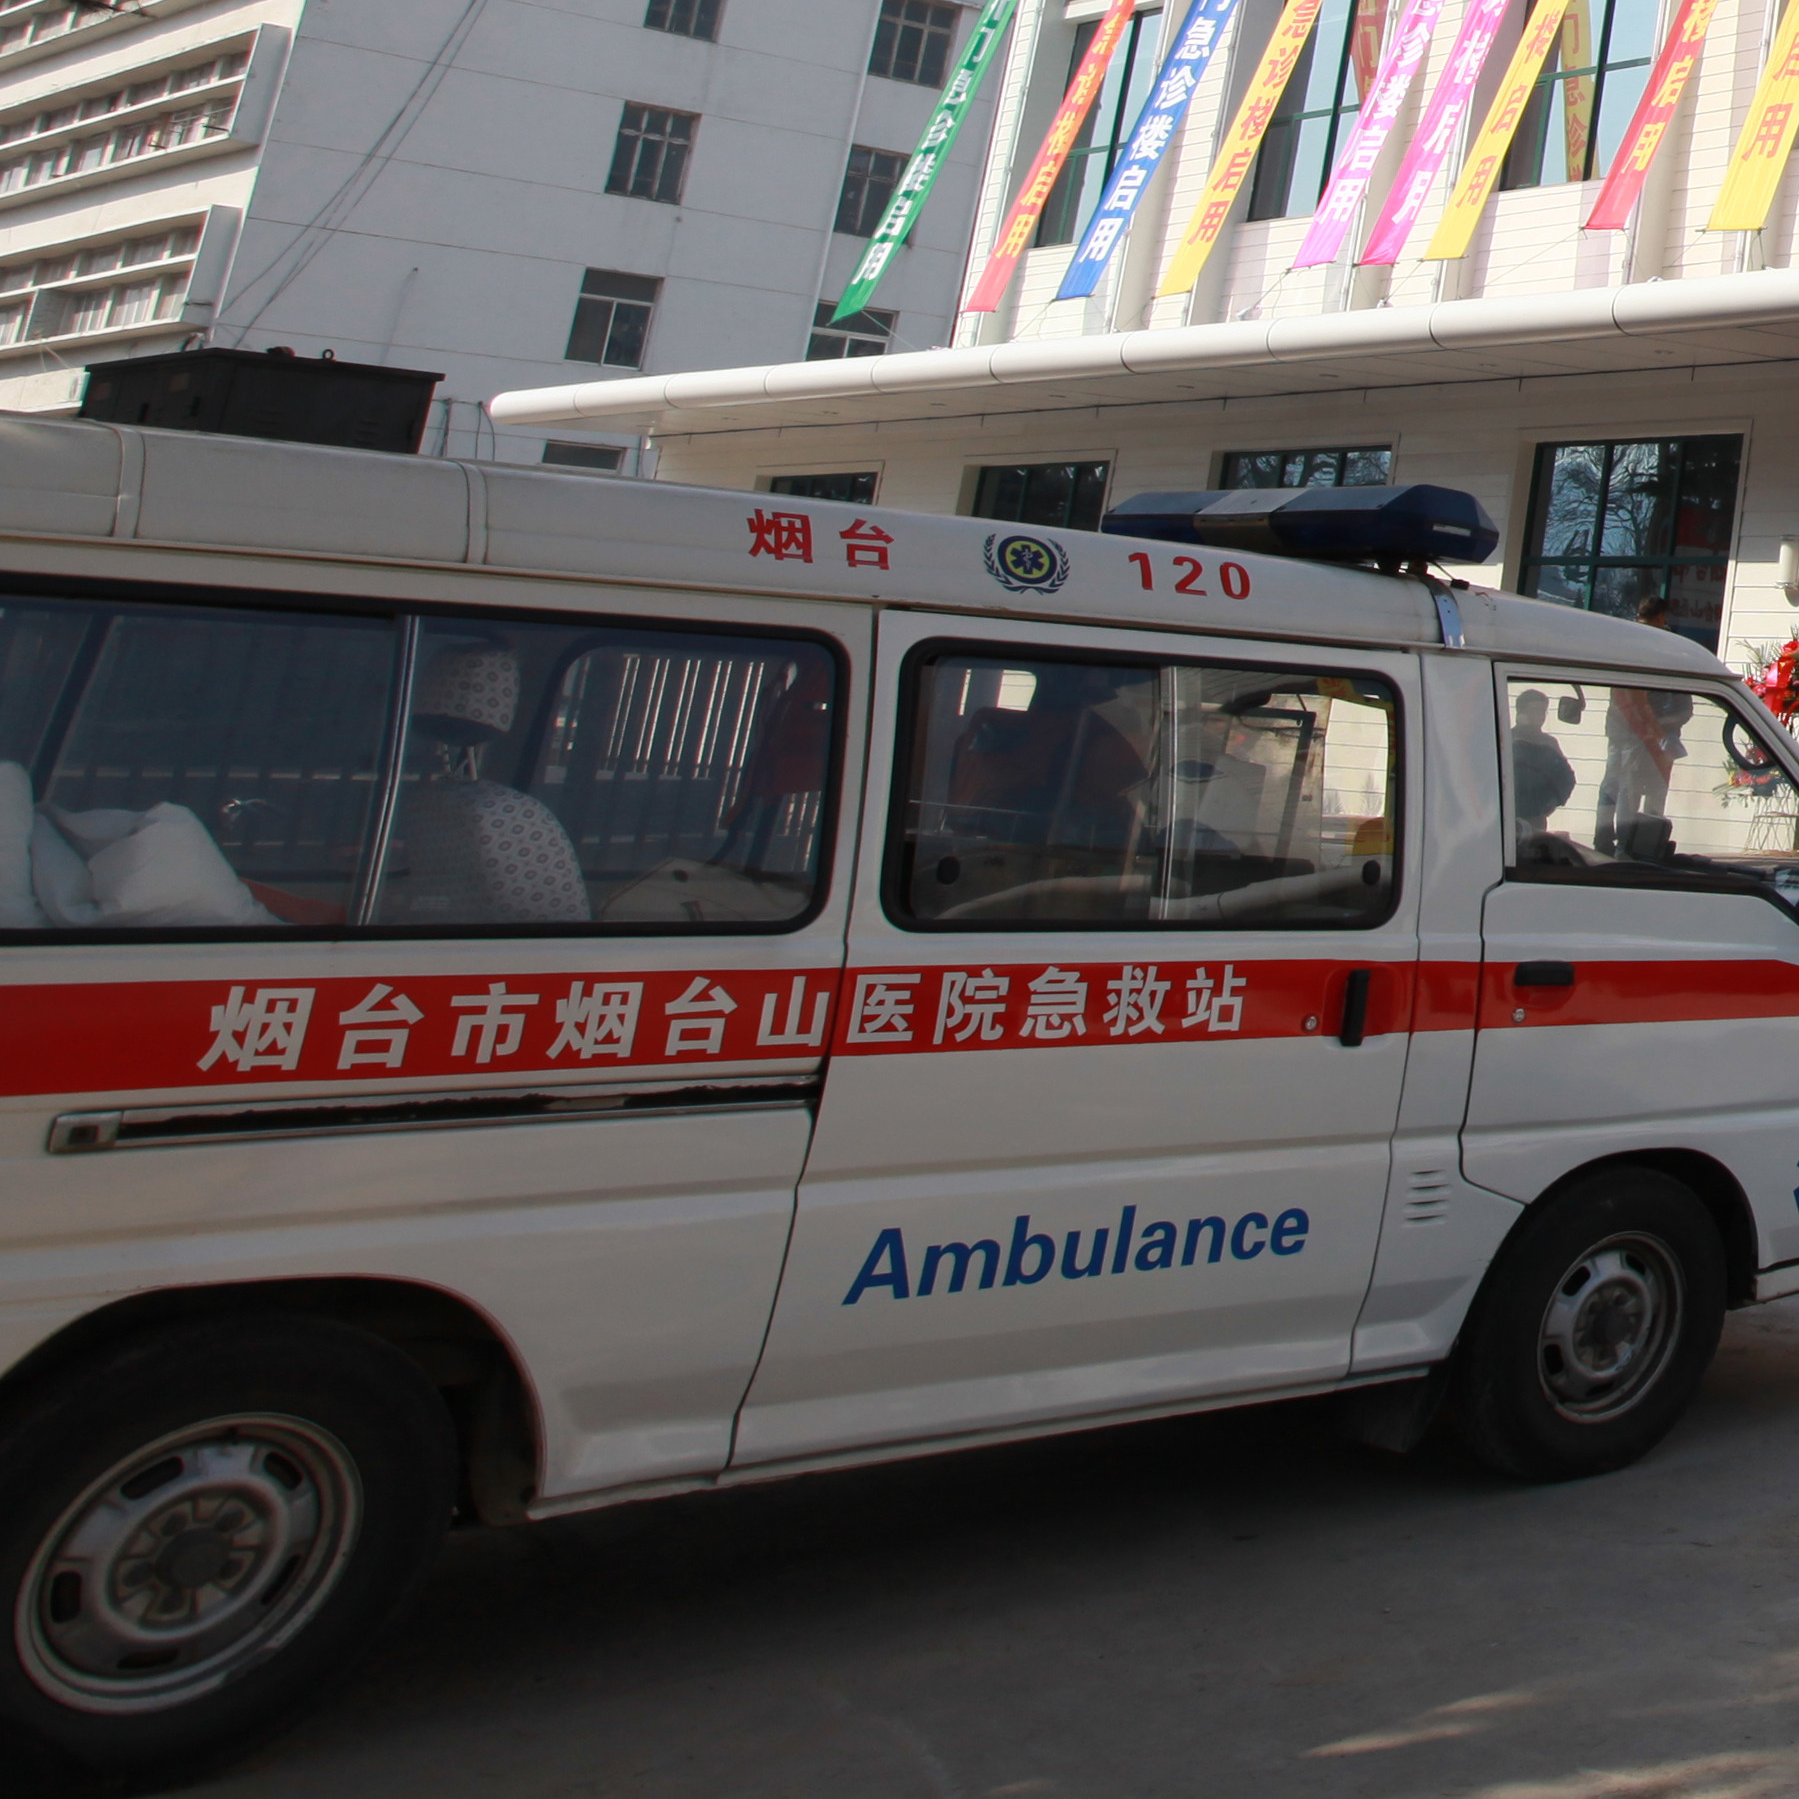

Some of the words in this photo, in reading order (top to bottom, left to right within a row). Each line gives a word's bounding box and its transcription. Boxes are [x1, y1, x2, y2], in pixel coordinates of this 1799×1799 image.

[748, 507, 894, 570] 烟台
[1128, 552, 1251, 600] 120
[197, 963, 1248, 1074] 烟台市烟台山医院急救站
[841, 1203, 1310, 1306] Ambulance
